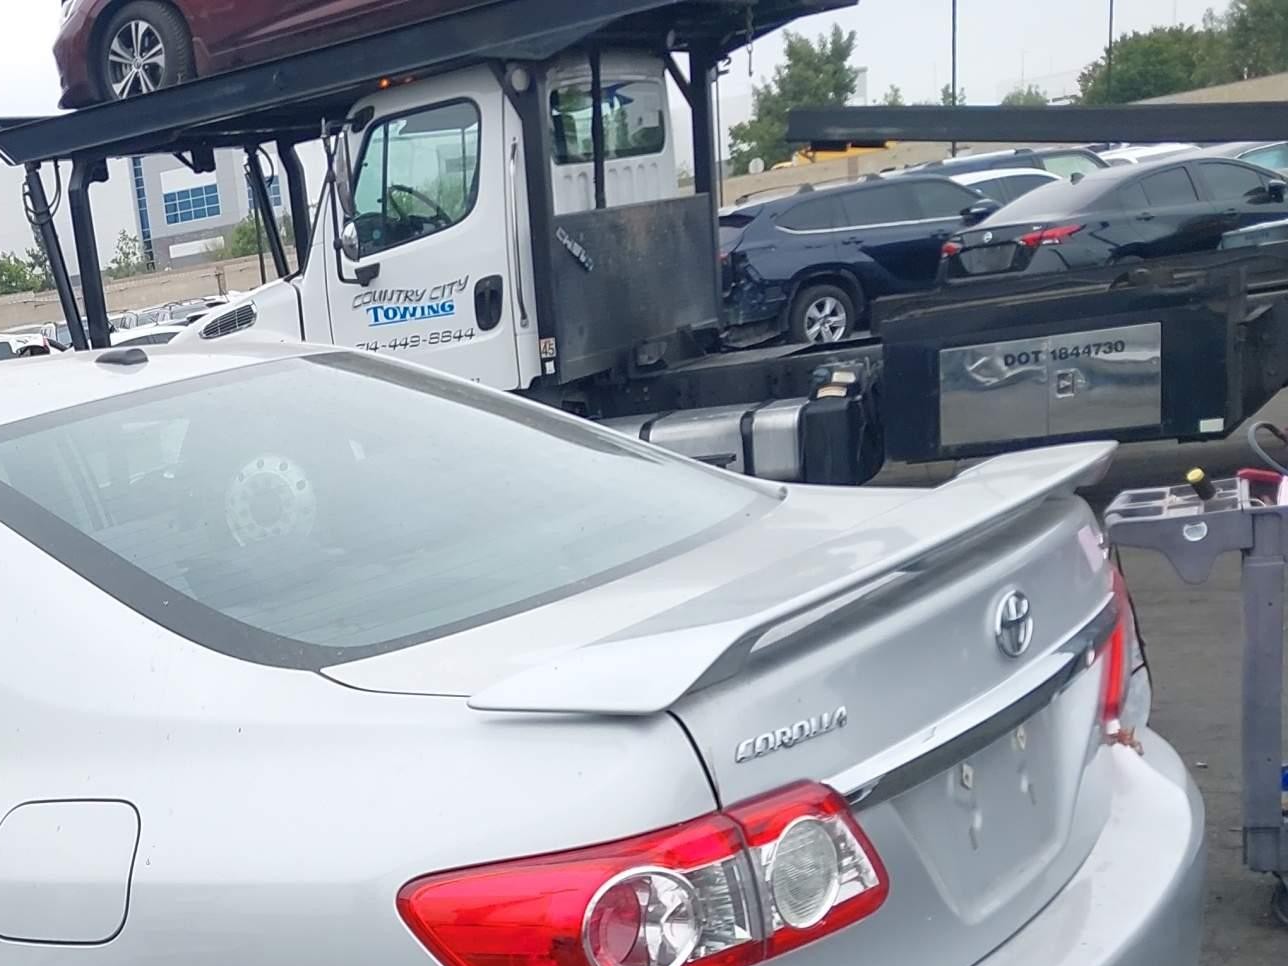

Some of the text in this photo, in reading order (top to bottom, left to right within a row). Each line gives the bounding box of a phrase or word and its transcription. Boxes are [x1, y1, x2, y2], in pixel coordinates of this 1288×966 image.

[352, 275, 470, 309] COUNTRY CITY
[366, 299, 455, 323] TOWING
[1003, 340, 1126, 367] DOT 1844730
[734, 705, 848, 764] COROLLA
